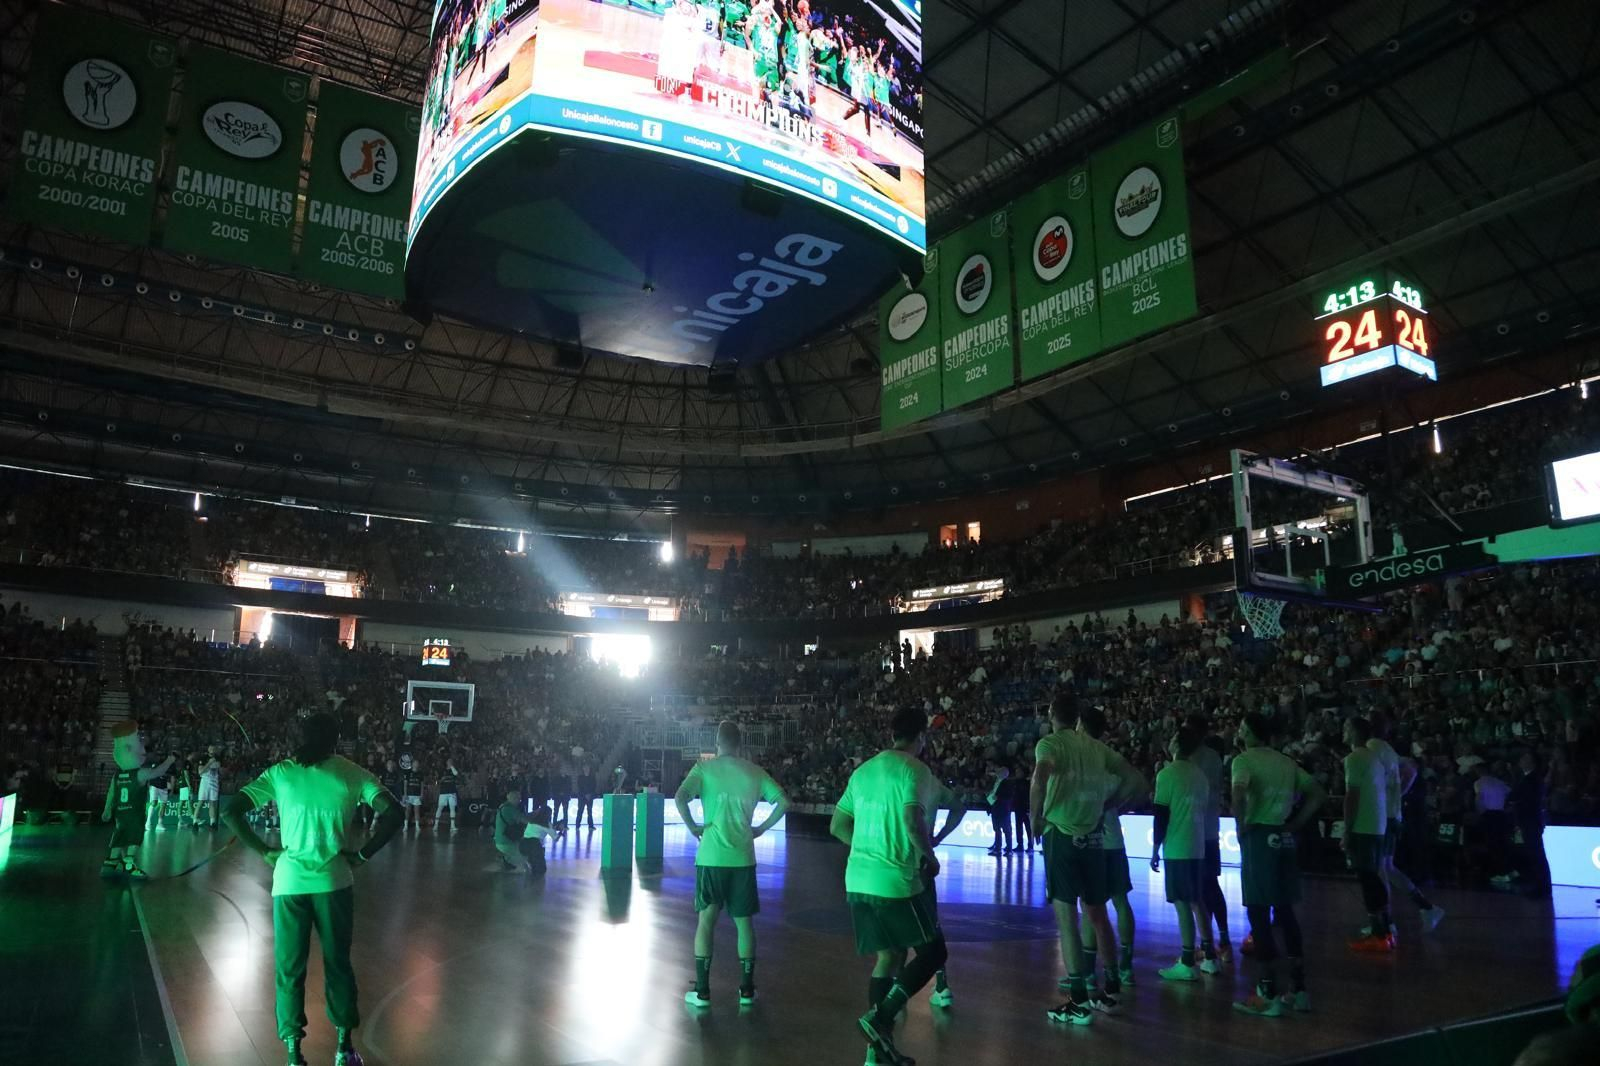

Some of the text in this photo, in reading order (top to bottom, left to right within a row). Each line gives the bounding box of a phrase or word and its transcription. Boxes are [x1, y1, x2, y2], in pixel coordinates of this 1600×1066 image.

[21, 130, 154, 183] CAMPEONES
[684, 134, 722, 152] unicajaCB
[24, 158, 144, 196] COPA KORAC
[372, 148, 386, 186] ACB
[38, 185, 128, 216] 2000/2001
[176, 166, 292, 214] CAMPEONES
[172, 190, 292, 228] COPA DEL REY
[212, 222, 249, 242] 2005
[336, 232, 384, 257] ACB
[321, 248, 394, 274] 2005/2006
[1102, 233, 1187, 290] CAMPEONES
[1132, 292, 1160, 314] 2025
[1133, 276, 1157, 296] BCL
[1324, 281, 1376, 313] 4:13
[1392, 281, 1422, 309] 4:13
[1022, 278, 1094, 330] CAMPEONES
[1022, 302, 1095, 340] COPA DEL REY
[944, 315, 1008, 360] CAMPEONES
[1048, 333, 1072, 354] 2025
[1326, 310, 1382, 363] 24
[1396, 310, 1428, 356] 24
[882, 346, 936, 386] CAMPEONES
[946, 336, 1010, 372] SUPERCOPA
[965, 363, 988, 382] 2024
[899, 392, 919, 408] 2024
[1349, 553, 1444, 588] endesa
[432, 648, 448, 658] 24
